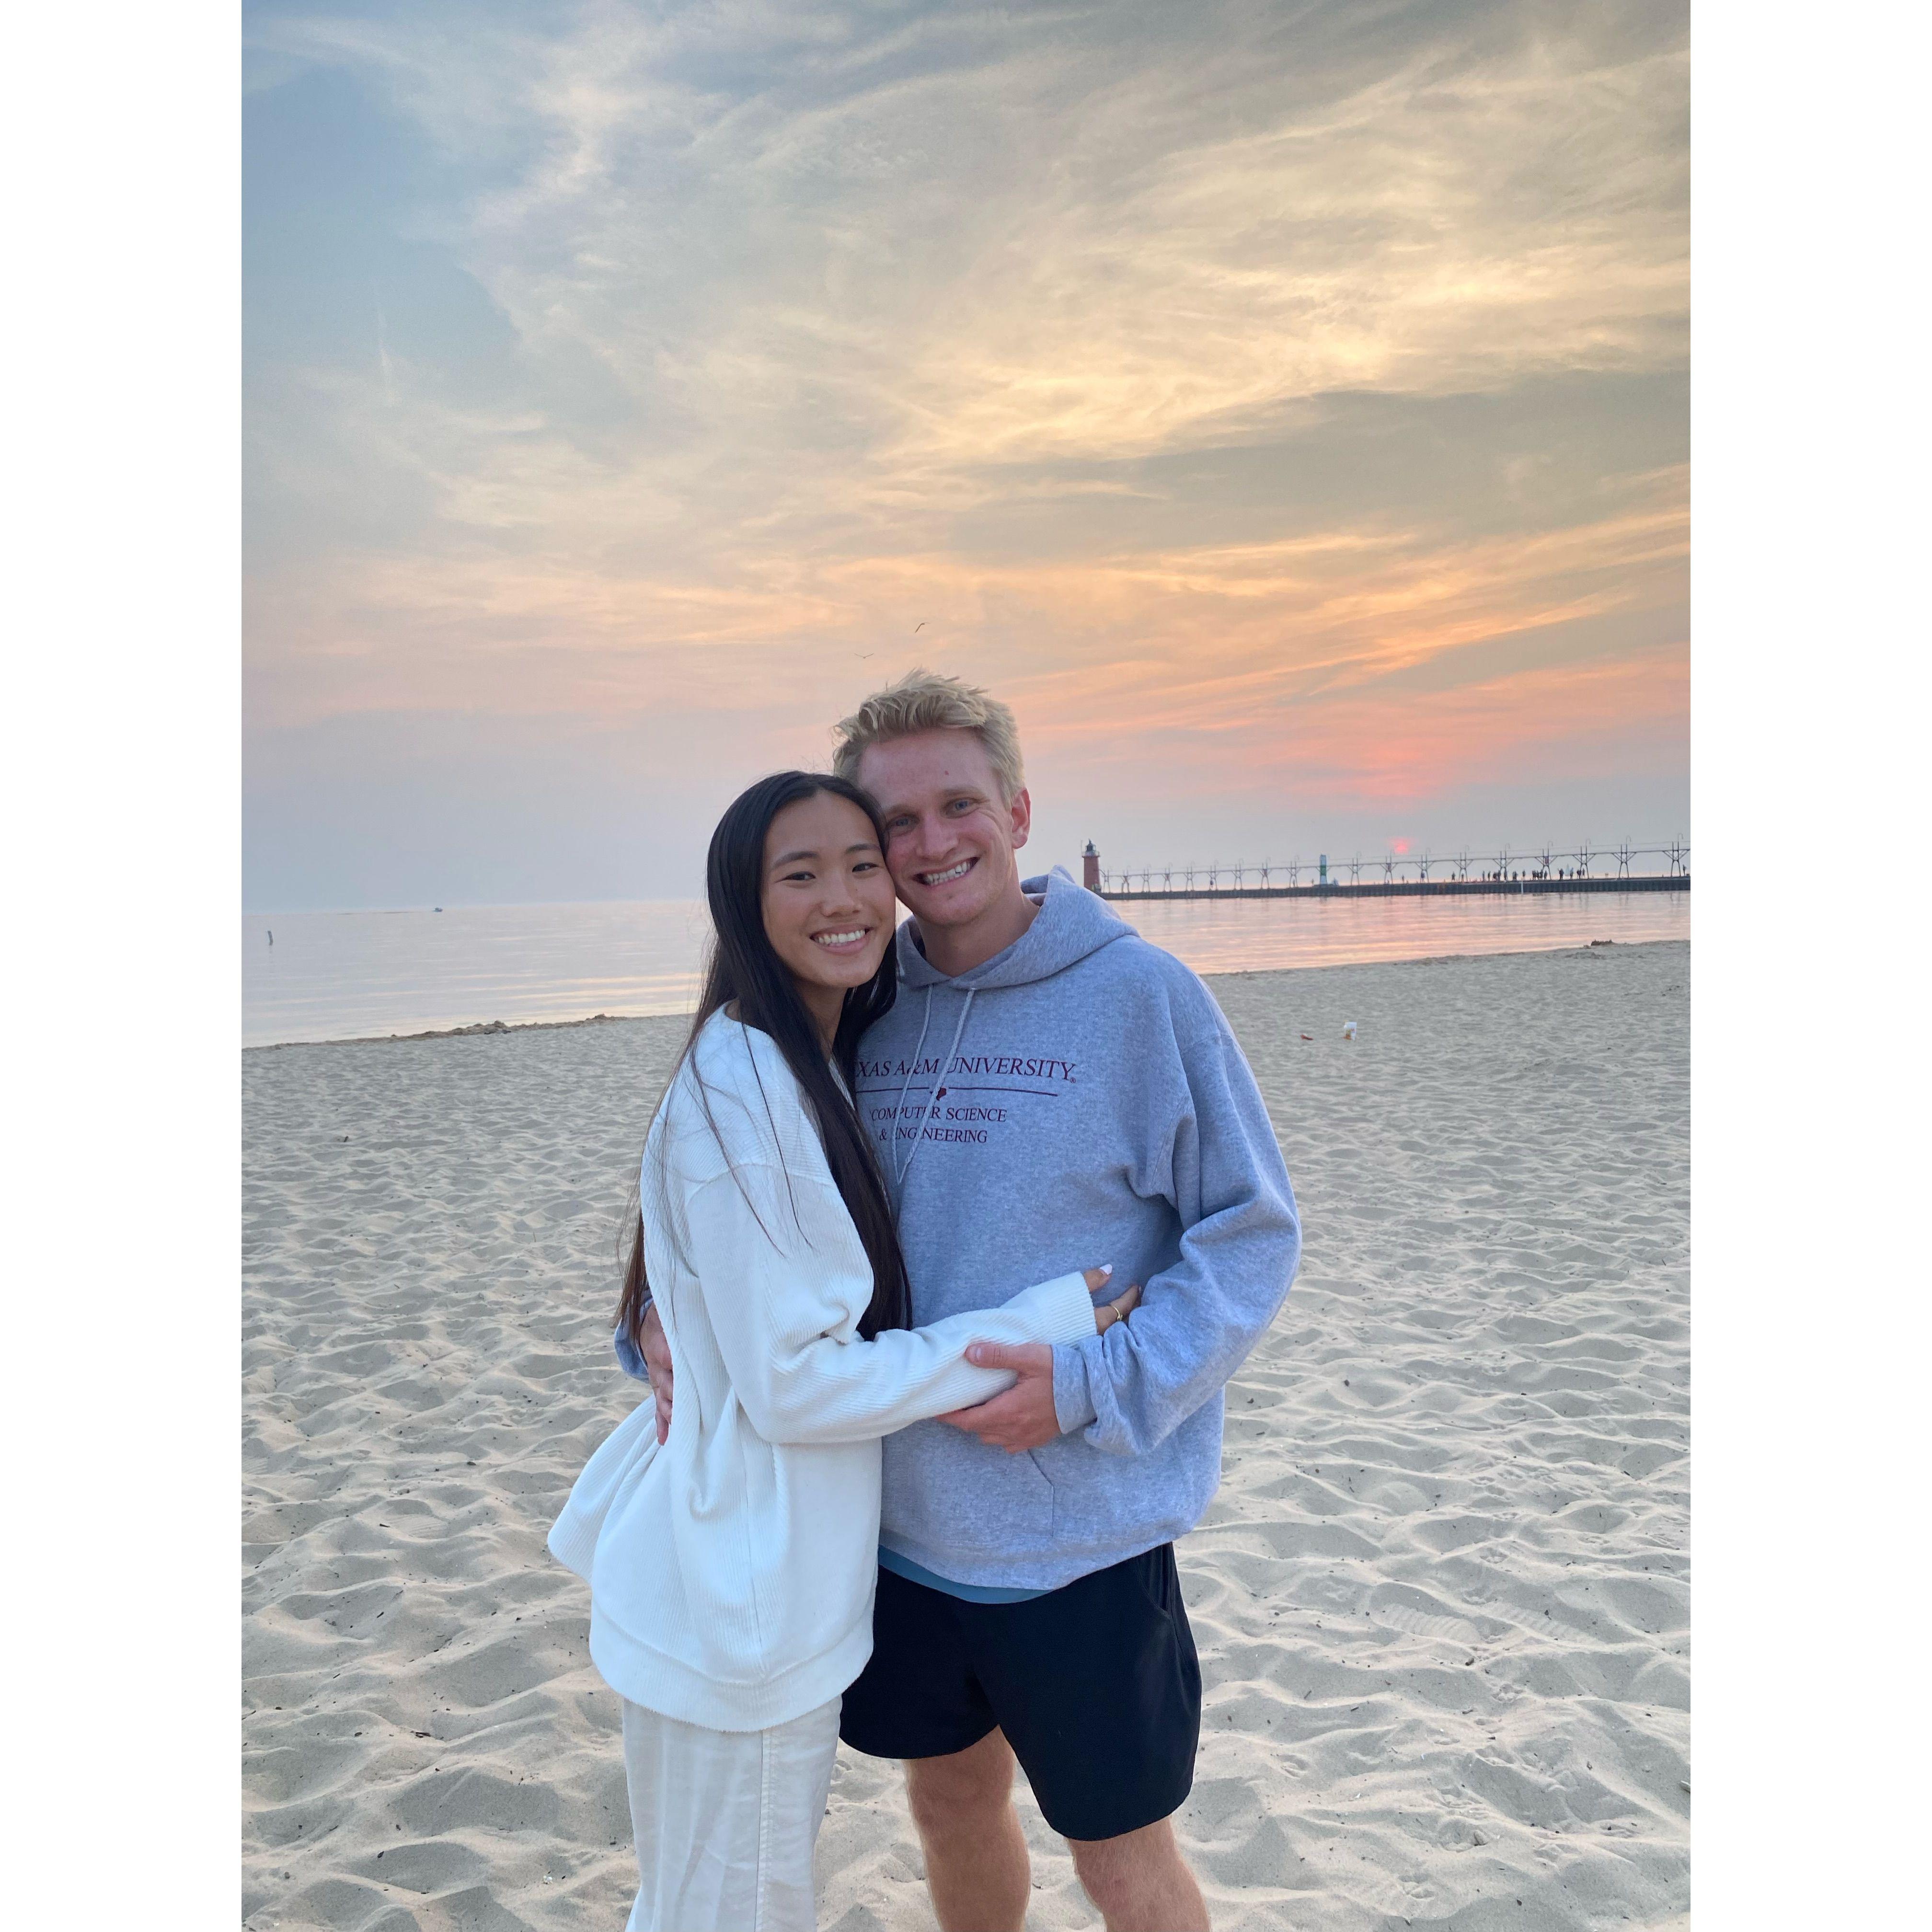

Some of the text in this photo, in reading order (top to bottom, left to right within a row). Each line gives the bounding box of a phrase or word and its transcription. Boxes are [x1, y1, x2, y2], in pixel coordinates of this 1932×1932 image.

[856, 1060, 891, 1077] XAS
[894, 1058, 940, 1075] A&M
[946, 1107, 1007, 1122] SCIENCE
[879, 1127, 988, 1143] & NGNEERING
